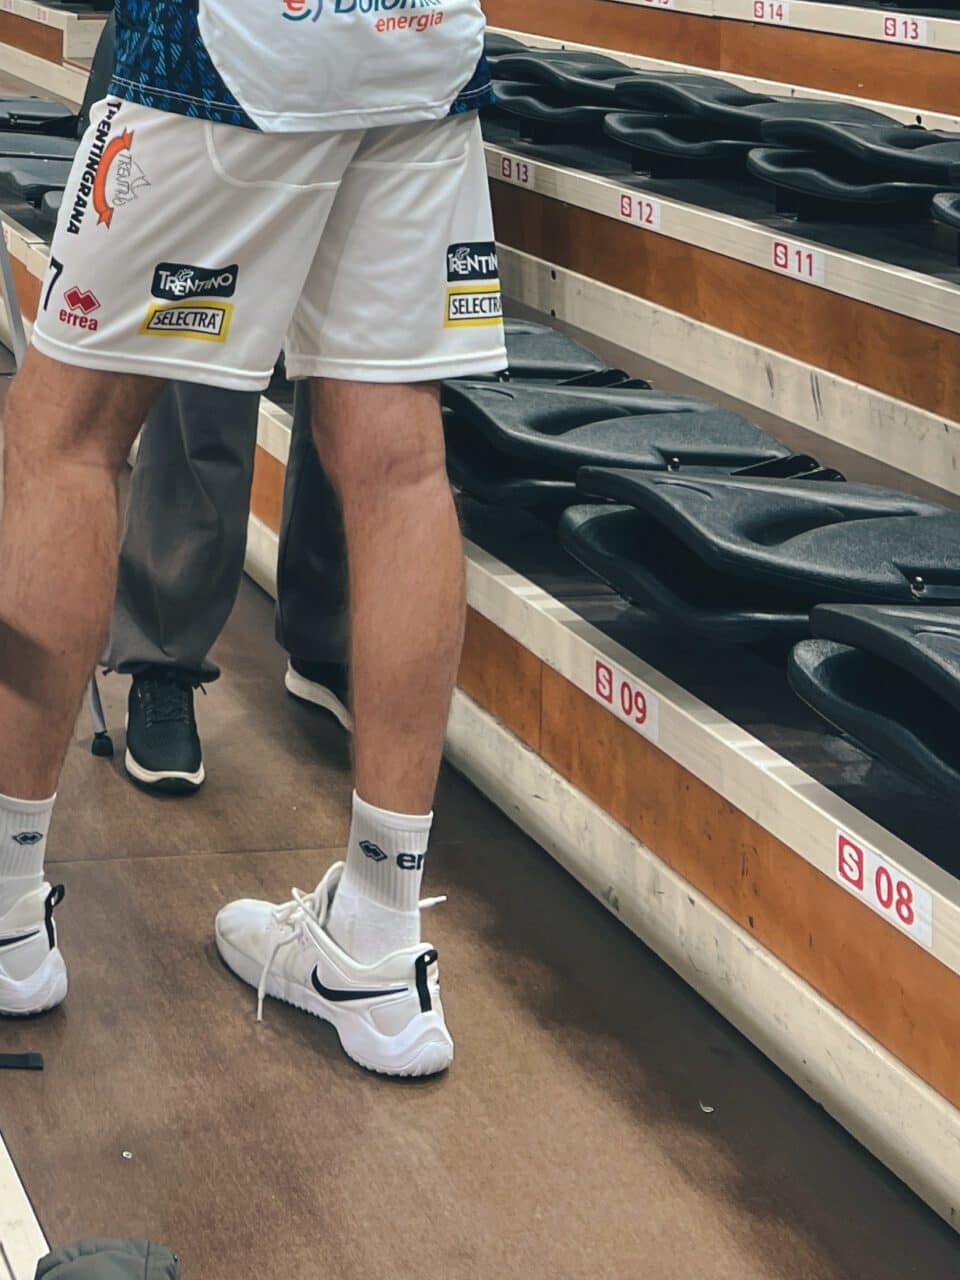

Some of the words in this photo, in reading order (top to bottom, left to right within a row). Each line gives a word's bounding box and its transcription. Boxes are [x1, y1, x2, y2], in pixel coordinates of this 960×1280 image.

[375, 10, 444, 33] energia
[769, 3, 783, 21] 14
[902, 20, 919, 40] 13
[515, 161, 529, 183] 13
[637, 201, 653, 224] 12
[795, 249, 814, 277] 11
[43, 255, 64, 311] 7
[158, 270, 233, 296] TRENTINO
[58, 307, 99, 332] errea
[152, 311, 220, 330] SELECTRA
[620, 681, 647, 725] 09
[874, 865, 915, 926] 08
